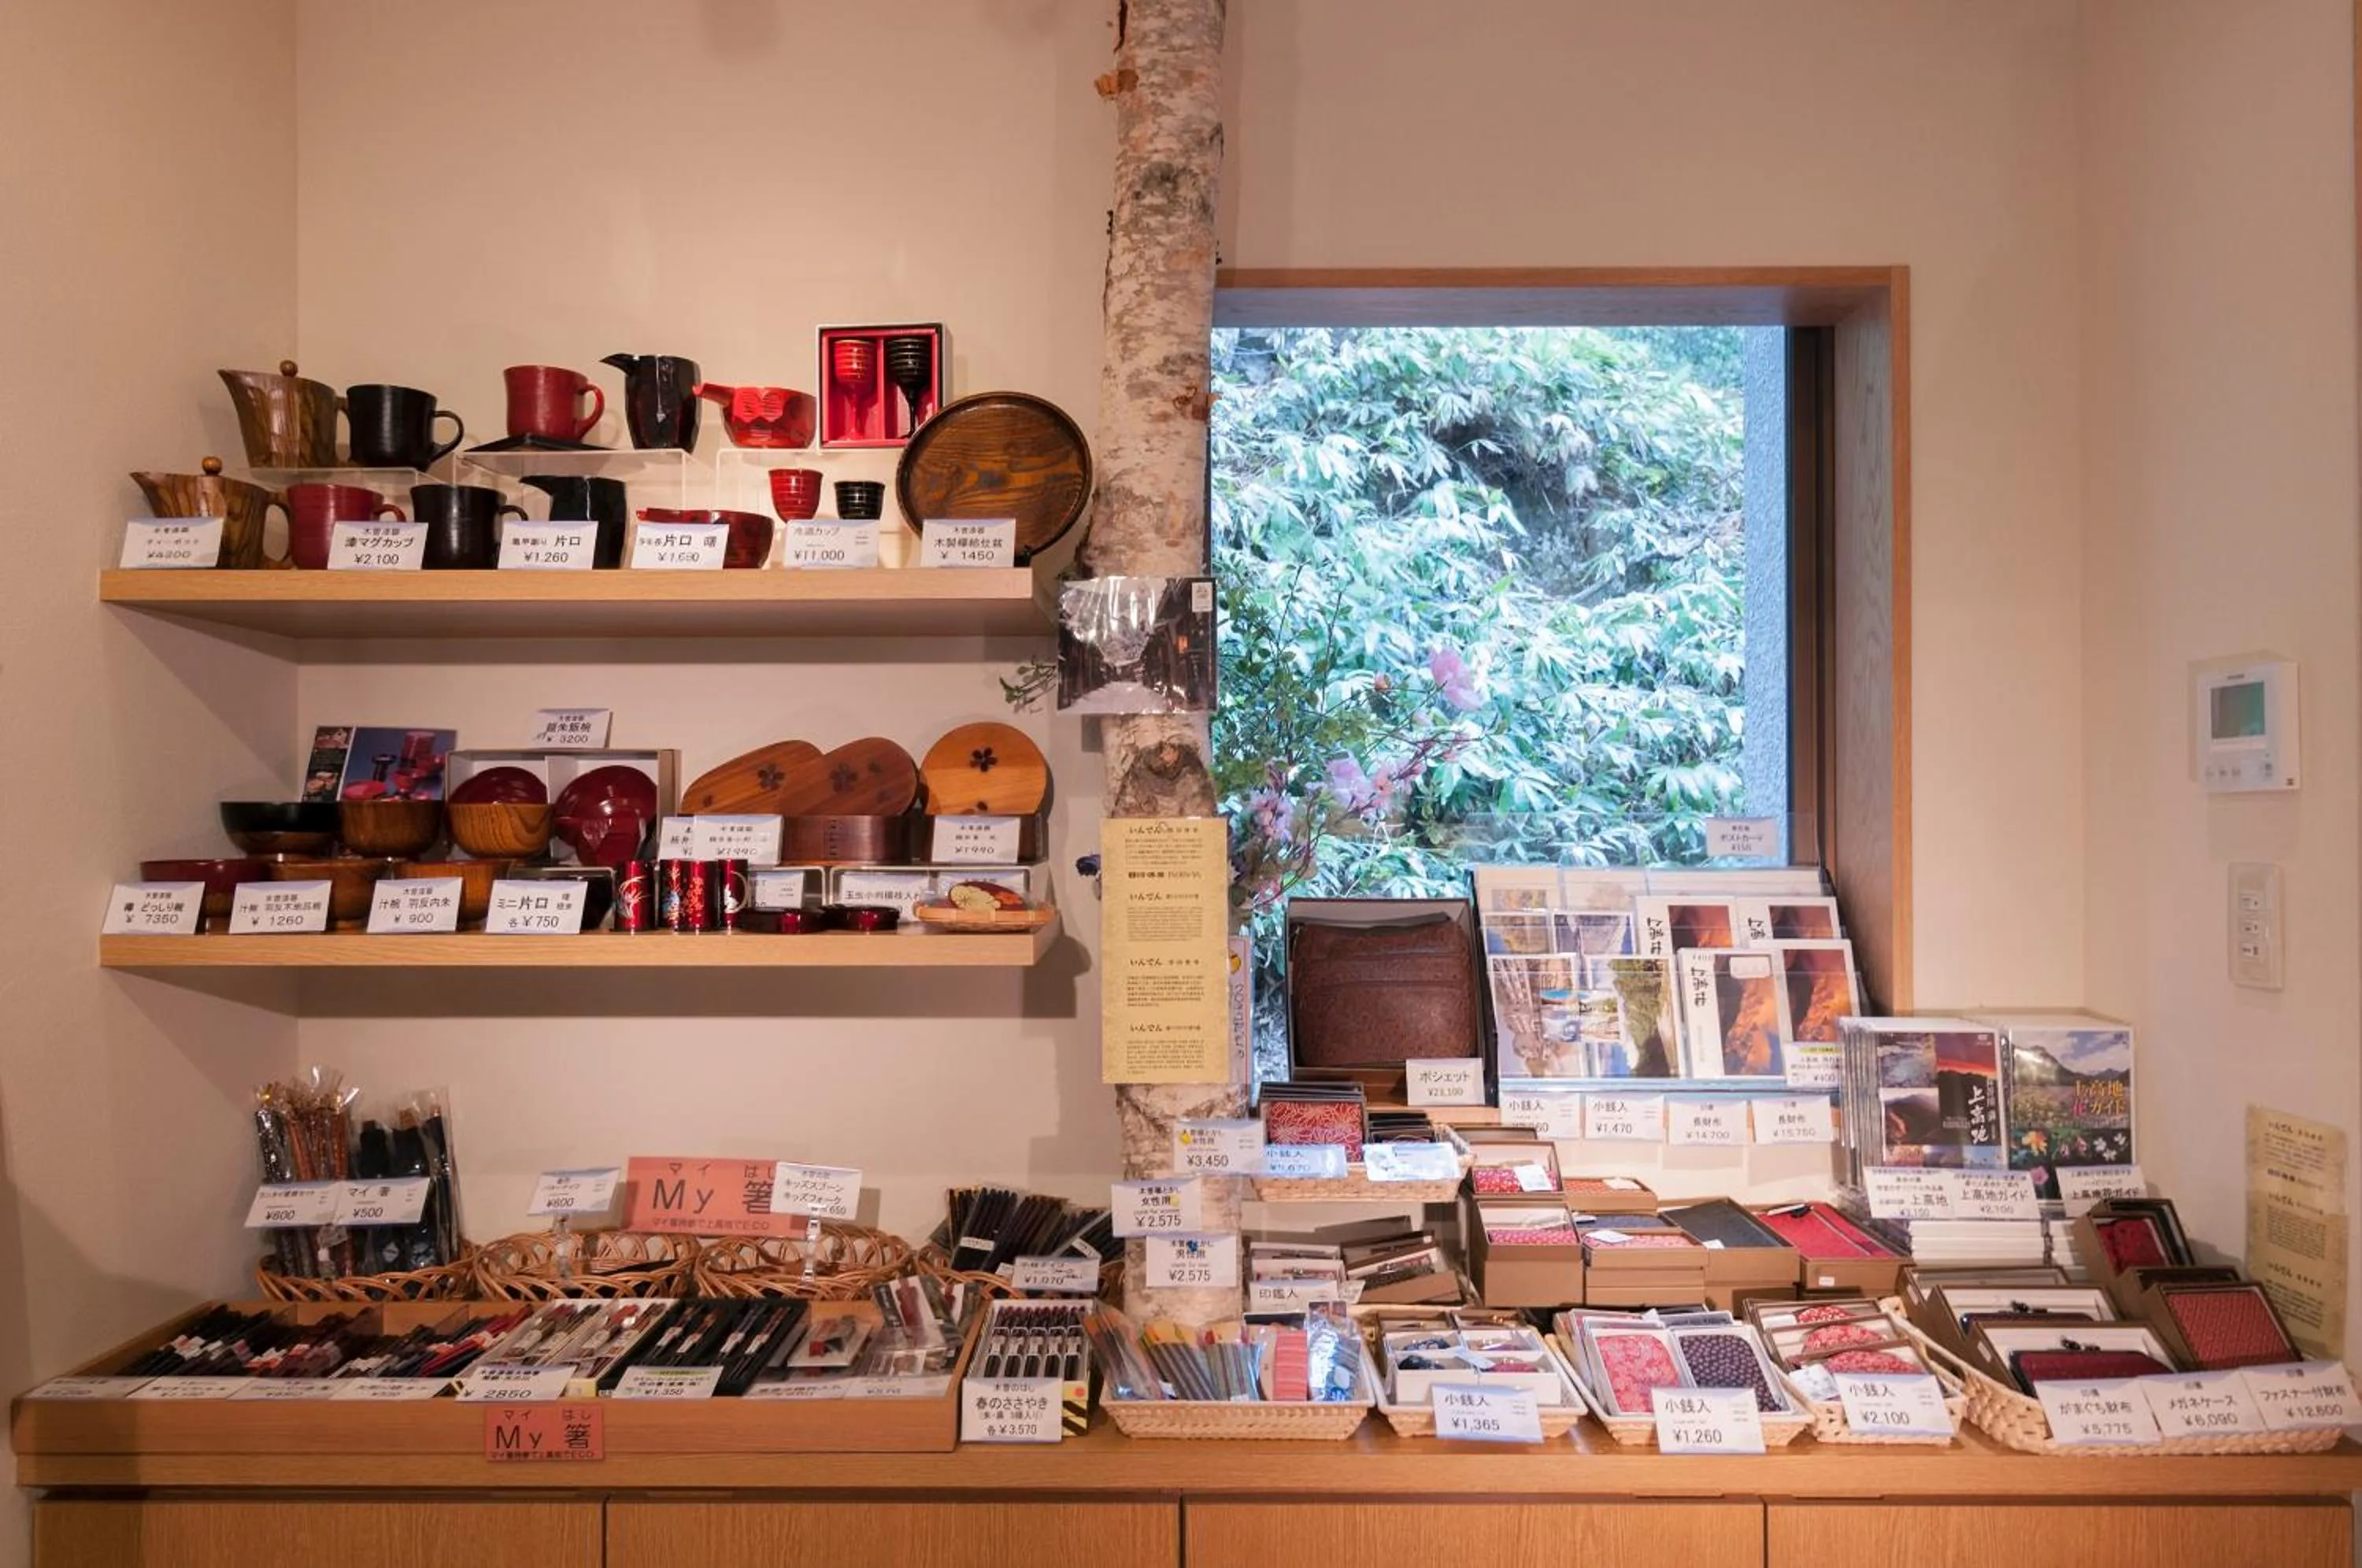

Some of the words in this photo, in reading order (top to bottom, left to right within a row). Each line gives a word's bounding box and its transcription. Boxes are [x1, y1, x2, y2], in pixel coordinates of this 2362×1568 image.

[554, 534, 581, 547] 片口
[1187, 1155, 1229, 1167] ¥3,450
[652, 1178, 715, 1215] My
[1135, 1215, 1182, 1227] ¥2,575
[1169, 1269, 1211, 1281] ¥2,575
[1849, 1383, 1896, 1397] 小銭入
[976, 1396, 1048, 1410] 春のささやき
[1445, 1394, 1490, 1407] 小銭入
[1665, 1398, 1712, 1414] 小銭入
[2169, 1395, 2238, 1409] メガネケース
[2060, 1401, 2133, 1415] がまぐち財布
[1451, 1416, 1500, 1433] ¥1,365
[1861, 1411, 1910, 1426] ¥2,100
[495, 1425, 543, 1450] My
[565, 1422, 591, 1450] 箸
[1672, 1429, 1723, 1444] ¥1,260
